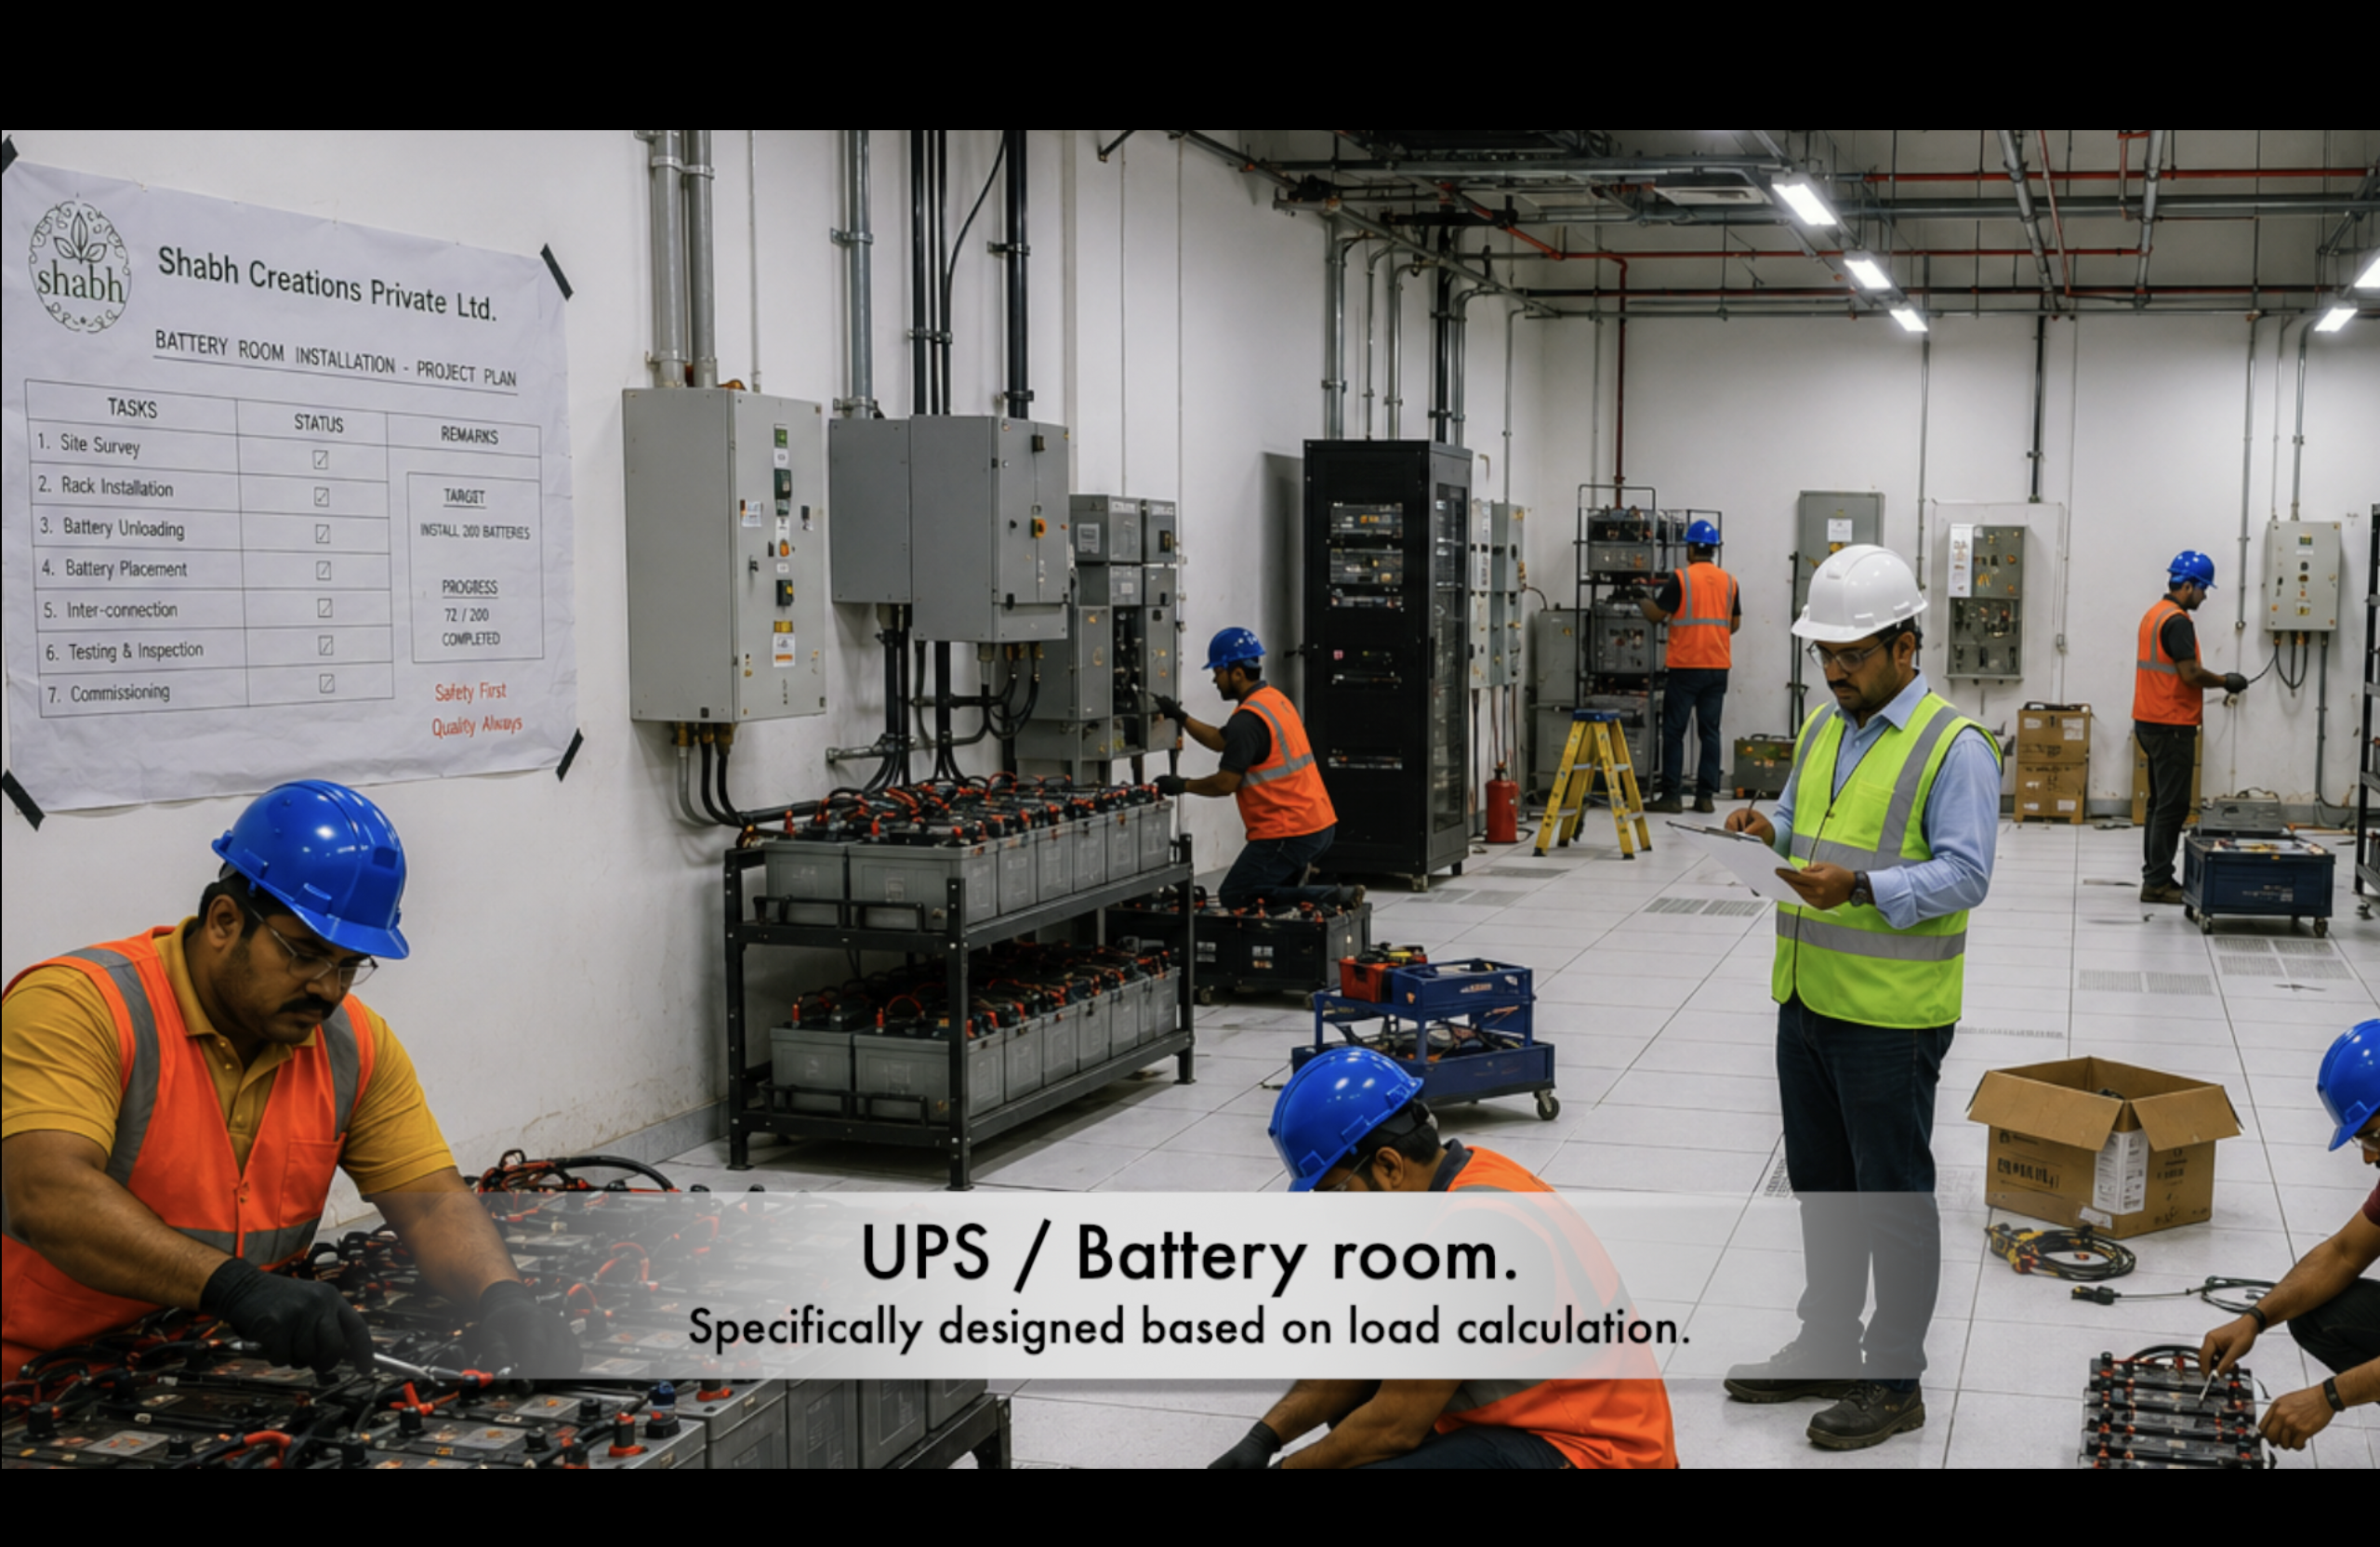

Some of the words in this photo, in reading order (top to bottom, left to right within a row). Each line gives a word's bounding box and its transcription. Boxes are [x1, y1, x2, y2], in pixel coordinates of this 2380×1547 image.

[37, 259, 125, 303] shabh
[158, 246, 239, 284] Shabh
[248, 260, 363, 301] Creations
[370, 280, 447, 313] Private
[456, 293, 496, 321] Ltd.
[155, 329, 228, 355] BATTERY
[238, 340, 284, 361] ROOM
[295, 347, 395, 374] INSTALLATION
[416, 361, 477, 382] PROJECT
[483, 368, 517, 387] PLAN
[107, 397, 158, 418] TASKS
[294, 414, 345, 433] STATUS
[441, 426, 499, 444] REMARKS
[37, 432, 51, 449] 1.
[60, 433, 88, 452] Site
[93, 436, 141, 460] Survey
[37, 475, 52, 492] 2.
[61, 476, 96, 494] Rack
[100, 479, 174, 496] Installation
[443, 488, 486, 504] TARGET
[39, 517, 54, 534] 3.
[62, 517, 113, 538] Battery
[118, 520, 185, 541] Unloading
[419, 523, 460, 537] INSTALL
[463, 524, 481, 537] 200
[41, 559, 55, 575] 4.
[65, 559, 115, 580] Battery
[119, 560, 188, 576] Placement
[442, 579, 499, 595] PROGRESS
[44, 602, 58, 618] 5.
[66, 601, 178, 617] Inter-connection
[444, 608, 458, 622] 72
[461, 608, 468, 622] /
[469, 608, 490, 622] 200
[442, 631, 501, 646] COMPLETED
[45, 644, 60, 661] 6.
[67, 643, 117, 663] Testing
[122, 642, 133, 658] &
[138, 641, 205, 662] Inspection
[47, 686, 61, 703] 7.
[70, 683, 171, 703] Commissioning
[435, 683, 474, 705] Safety
[479, 682, 507, 698] First
